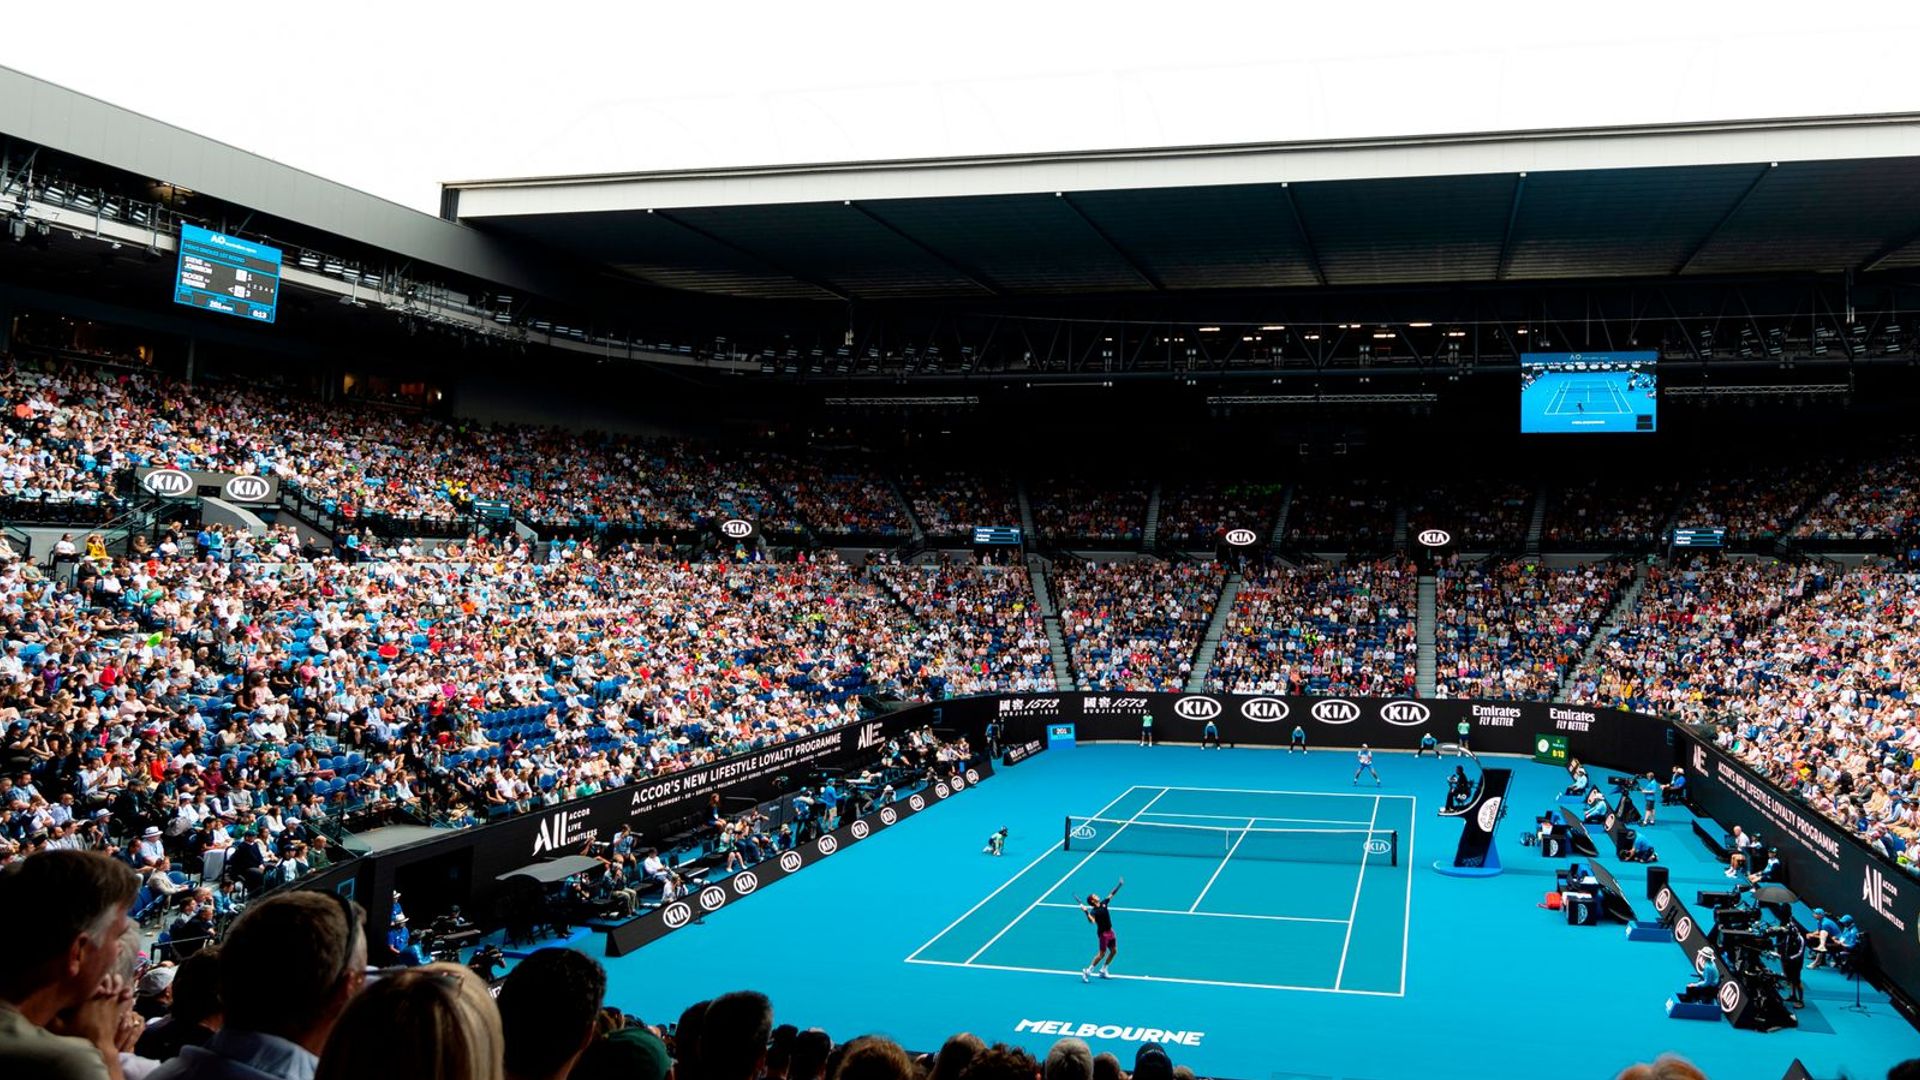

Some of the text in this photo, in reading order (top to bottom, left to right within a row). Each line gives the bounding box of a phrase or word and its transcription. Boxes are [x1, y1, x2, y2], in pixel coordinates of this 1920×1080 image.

[151, 474, 184, 491] KIA
[234, 480, 262, 496] KIA
[1182, 701, 1214, 715] KIA
[1249, 703, 1281, 717] KIA
[1319, 705, 1352, 719] KIA
[1389, 706, 1421, 720] KIA
[1472, 705, 1521, 718] Emirates
[1549, 708, 1596, 723] Emirates
[631, 732, 842, 806] ACCOR'S NEW LIFESTYLE LOYALTY PROGRAMME
[569, 808, 590, 820] ACCOR
[568, 821, 581, 833] LIVE
[1771, 798, 1796, 826] LOYALTY
[1796, 815, 1840, 858] PROGRAMME
[567, 828, 598, 844] LIMITLESS
[737, 874, 754, 891] KIA
[703, 890, 723, 907] KIA
[667, 906, 688, 924] KIA
[1014, 1018, 1205, 1046] MELBOURNE
